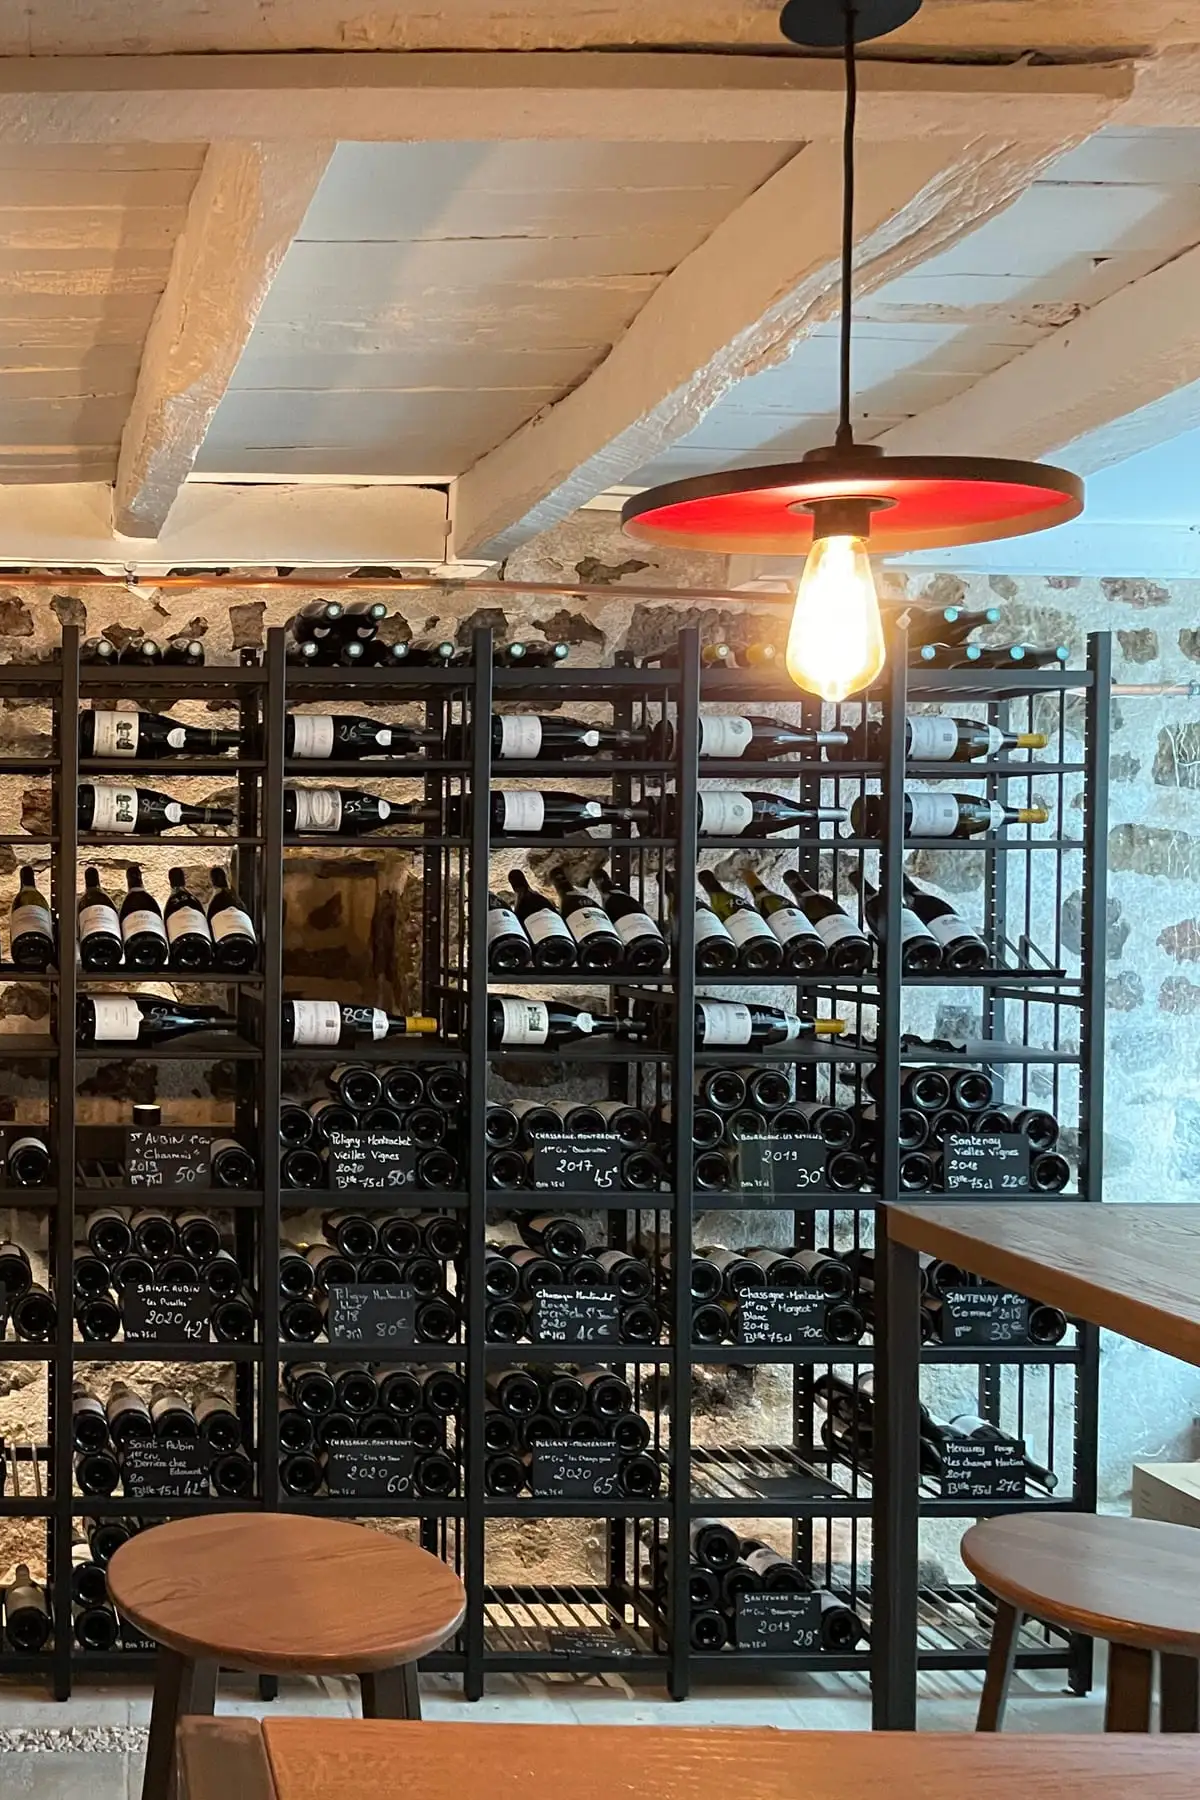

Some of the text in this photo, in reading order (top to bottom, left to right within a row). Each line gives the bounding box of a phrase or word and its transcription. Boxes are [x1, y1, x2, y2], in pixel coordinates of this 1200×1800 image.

[762, 1150, 798, 1164] 2019
[556, 1159, 594, 1173] 2017
[946, 1292, 999, 1307] SANTENAY
[145, 1310, 183, 1325] 2020
[334, 1310, 360, 1322] 2018
[743, 1321, 770, 1331] 2018
[346, 1465, 388, 1481] 2020
[553, 1466, 592, 1481] 2020
[757, 1620, 790, 1634] 2019
